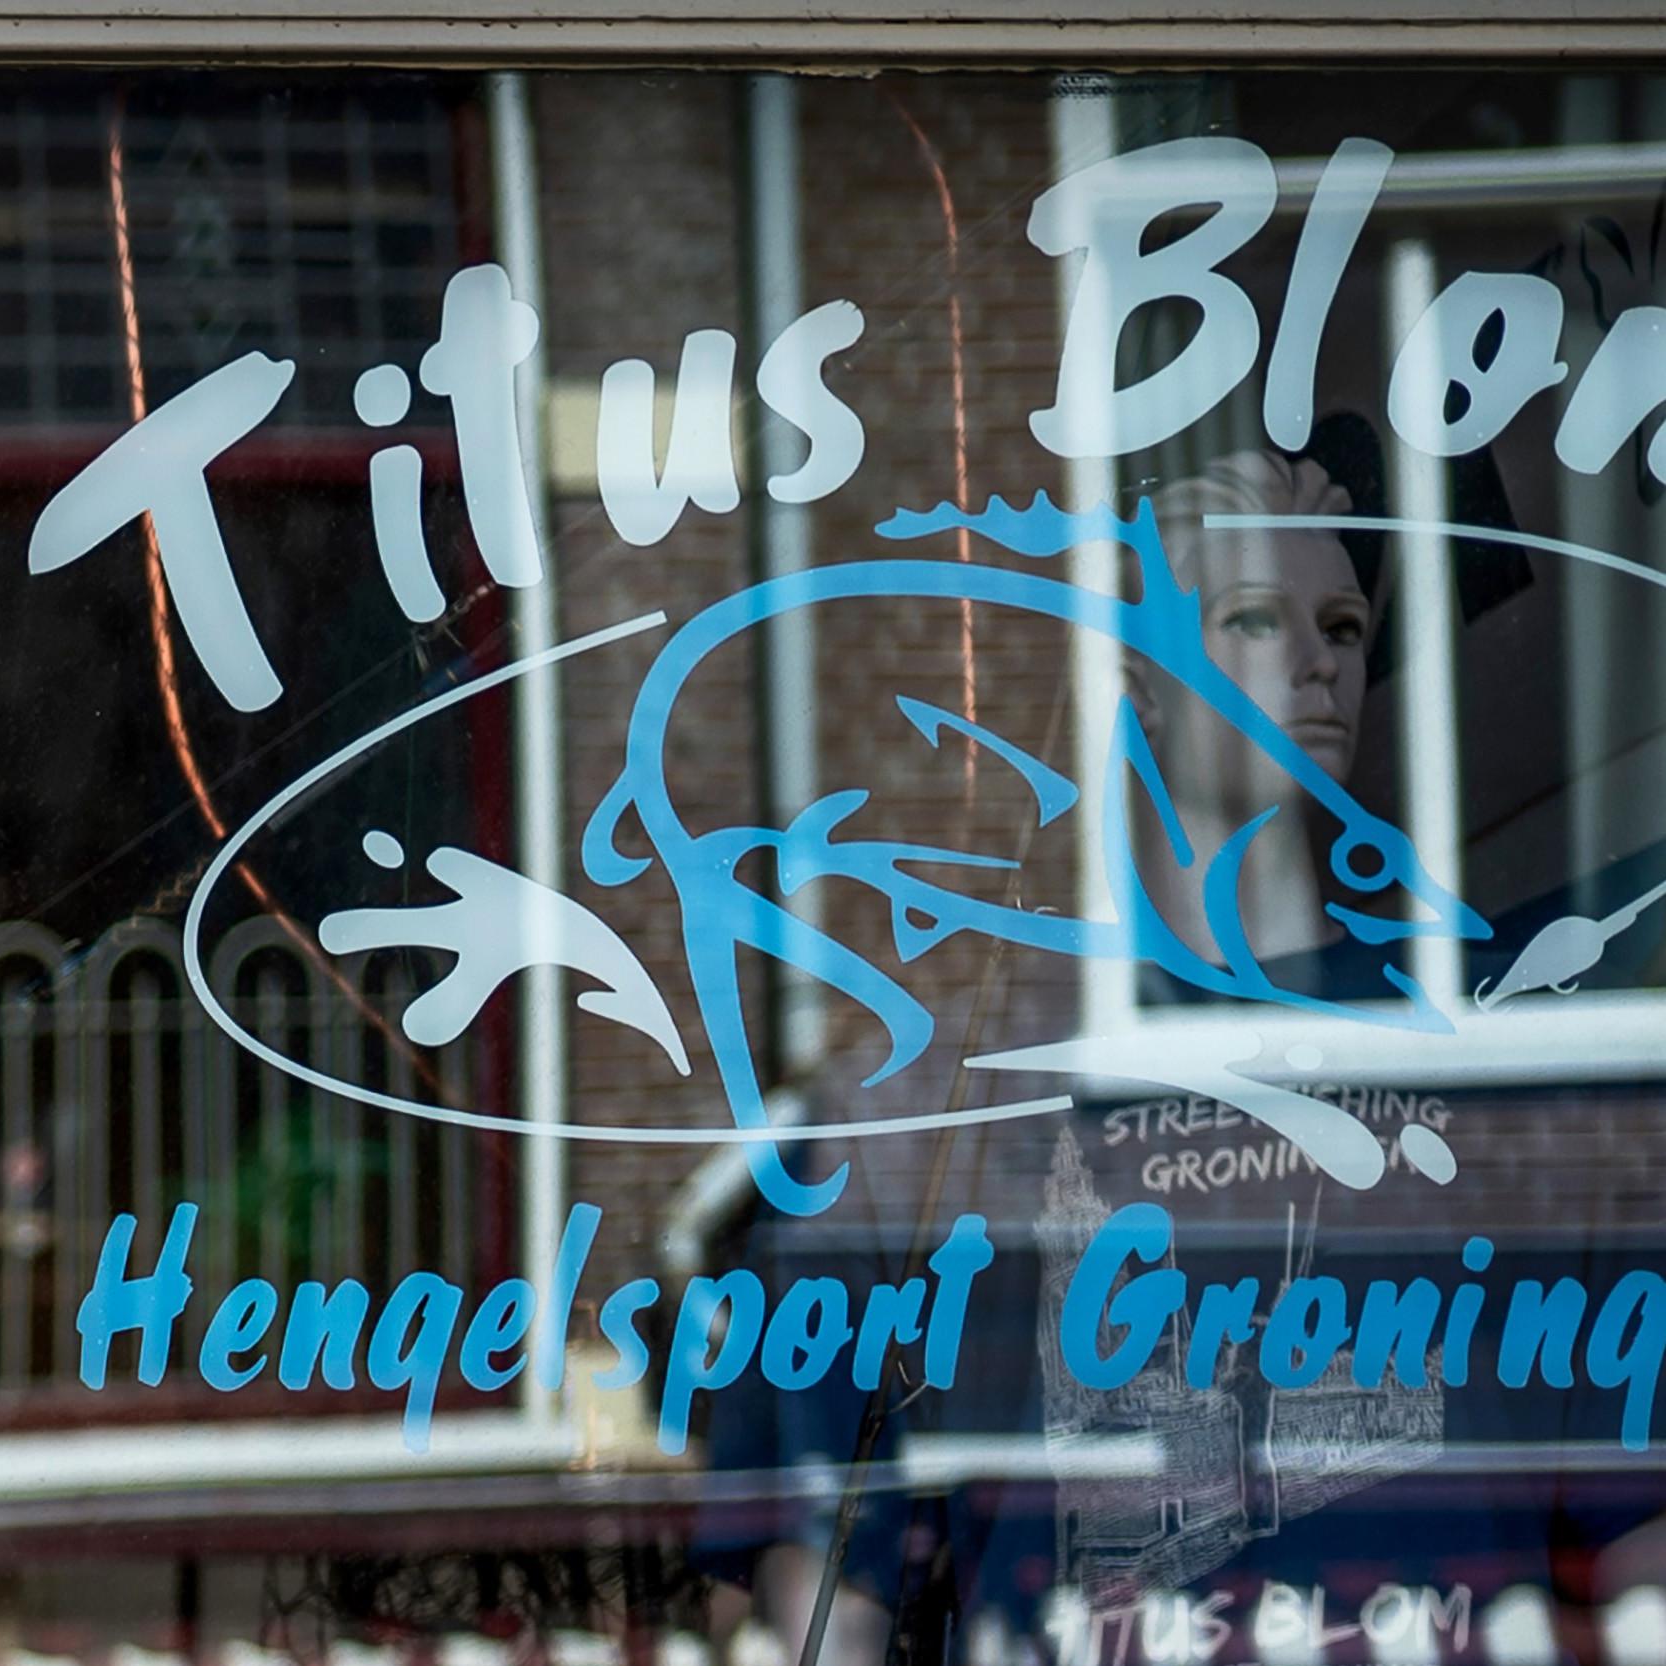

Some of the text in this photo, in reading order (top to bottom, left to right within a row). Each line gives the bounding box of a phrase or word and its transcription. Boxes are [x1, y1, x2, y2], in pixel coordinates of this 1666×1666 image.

[28, 261, 867, 713] Titus
[75, 1203, 992, 1456] Hengelsport
[1253, 1581, 1472, 1654] BLOM
